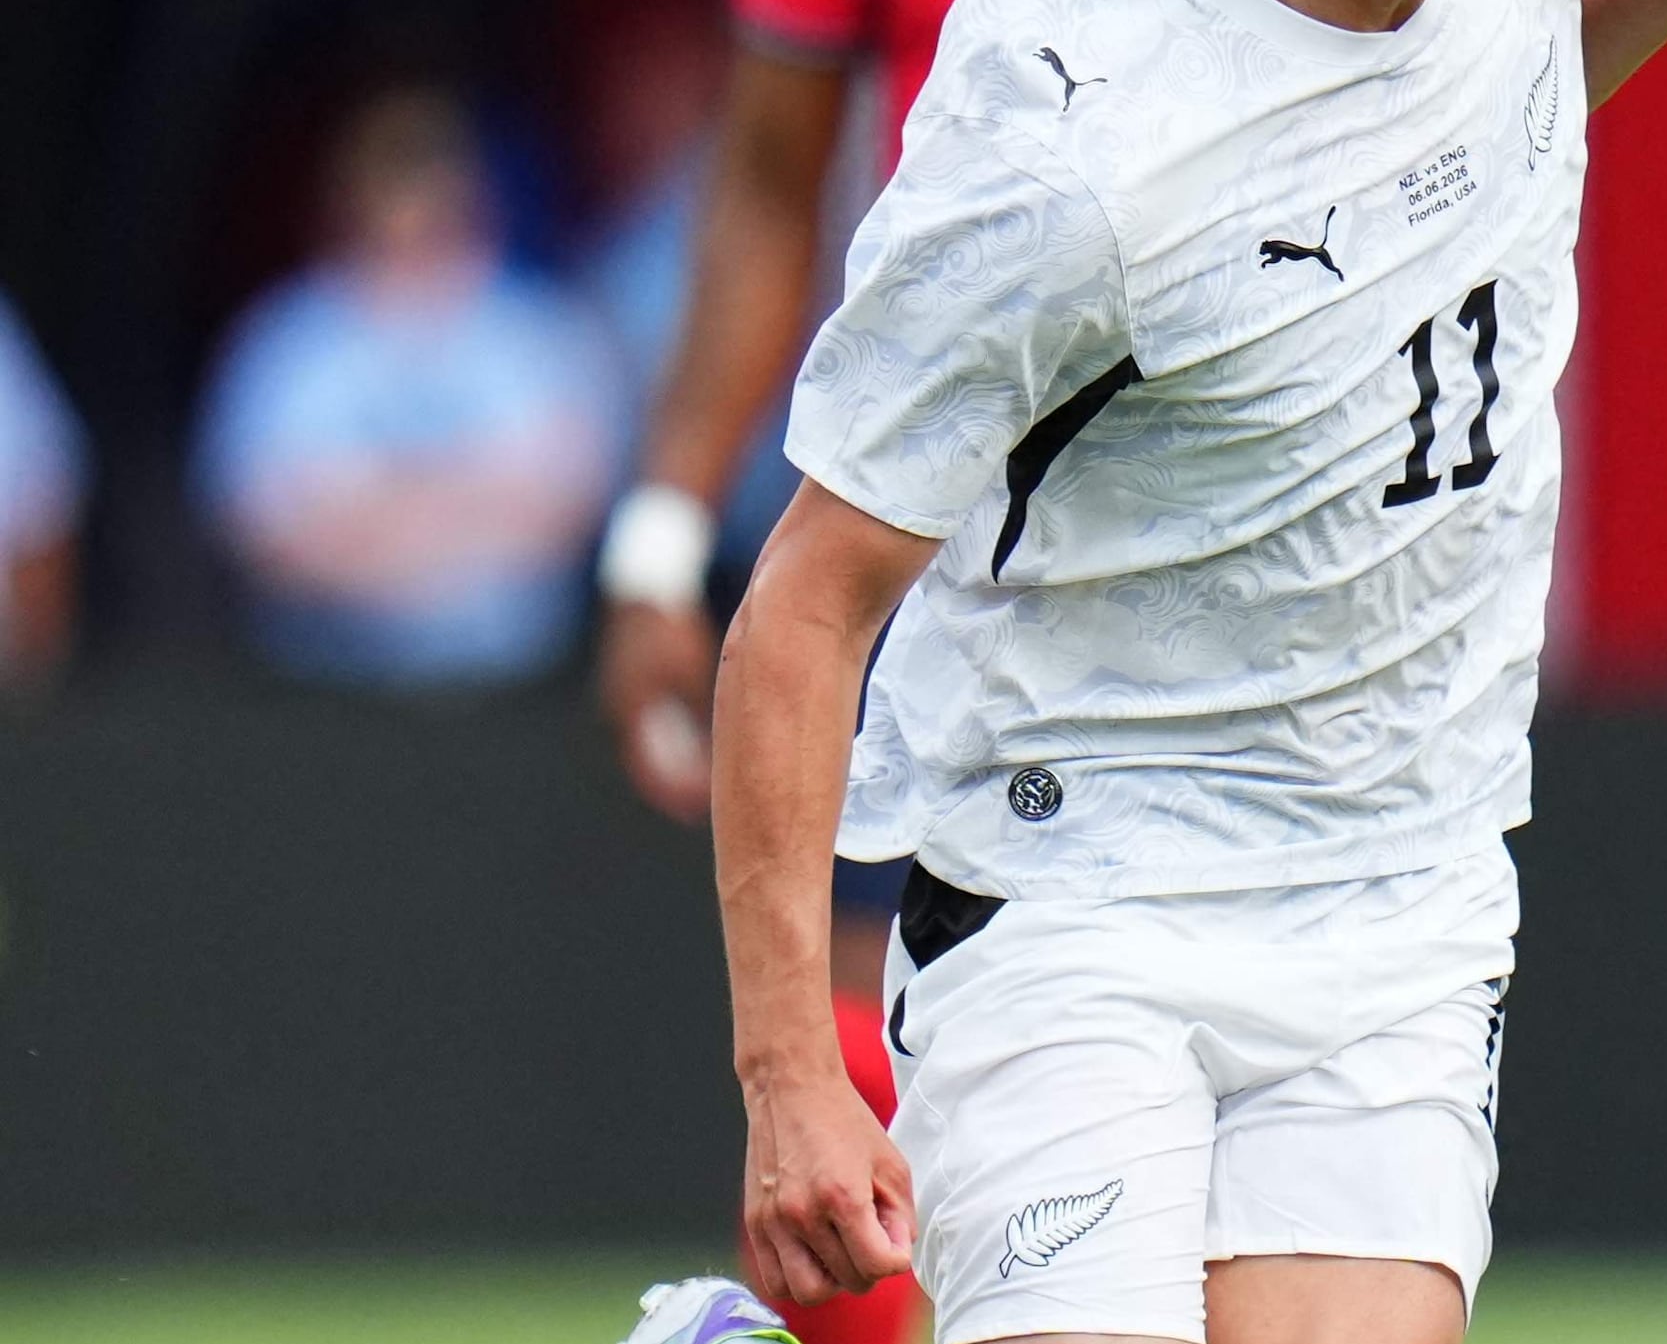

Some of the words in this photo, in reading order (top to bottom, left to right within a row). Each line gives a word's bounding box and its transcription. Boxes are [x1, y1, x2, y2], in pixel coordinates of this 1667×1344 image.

[1398, 171, 1423, 191] NZL
[1424, 163, 1439, 176] vs
[1440, 145, 1467, 168] ENG
[1408, 165, 1469, 206] 06.06.2026
[1408, 198, 1454, 227] Florida,
[1454, 180, 1478, 201] USA
[1382, 278, 1503, 509] 11
